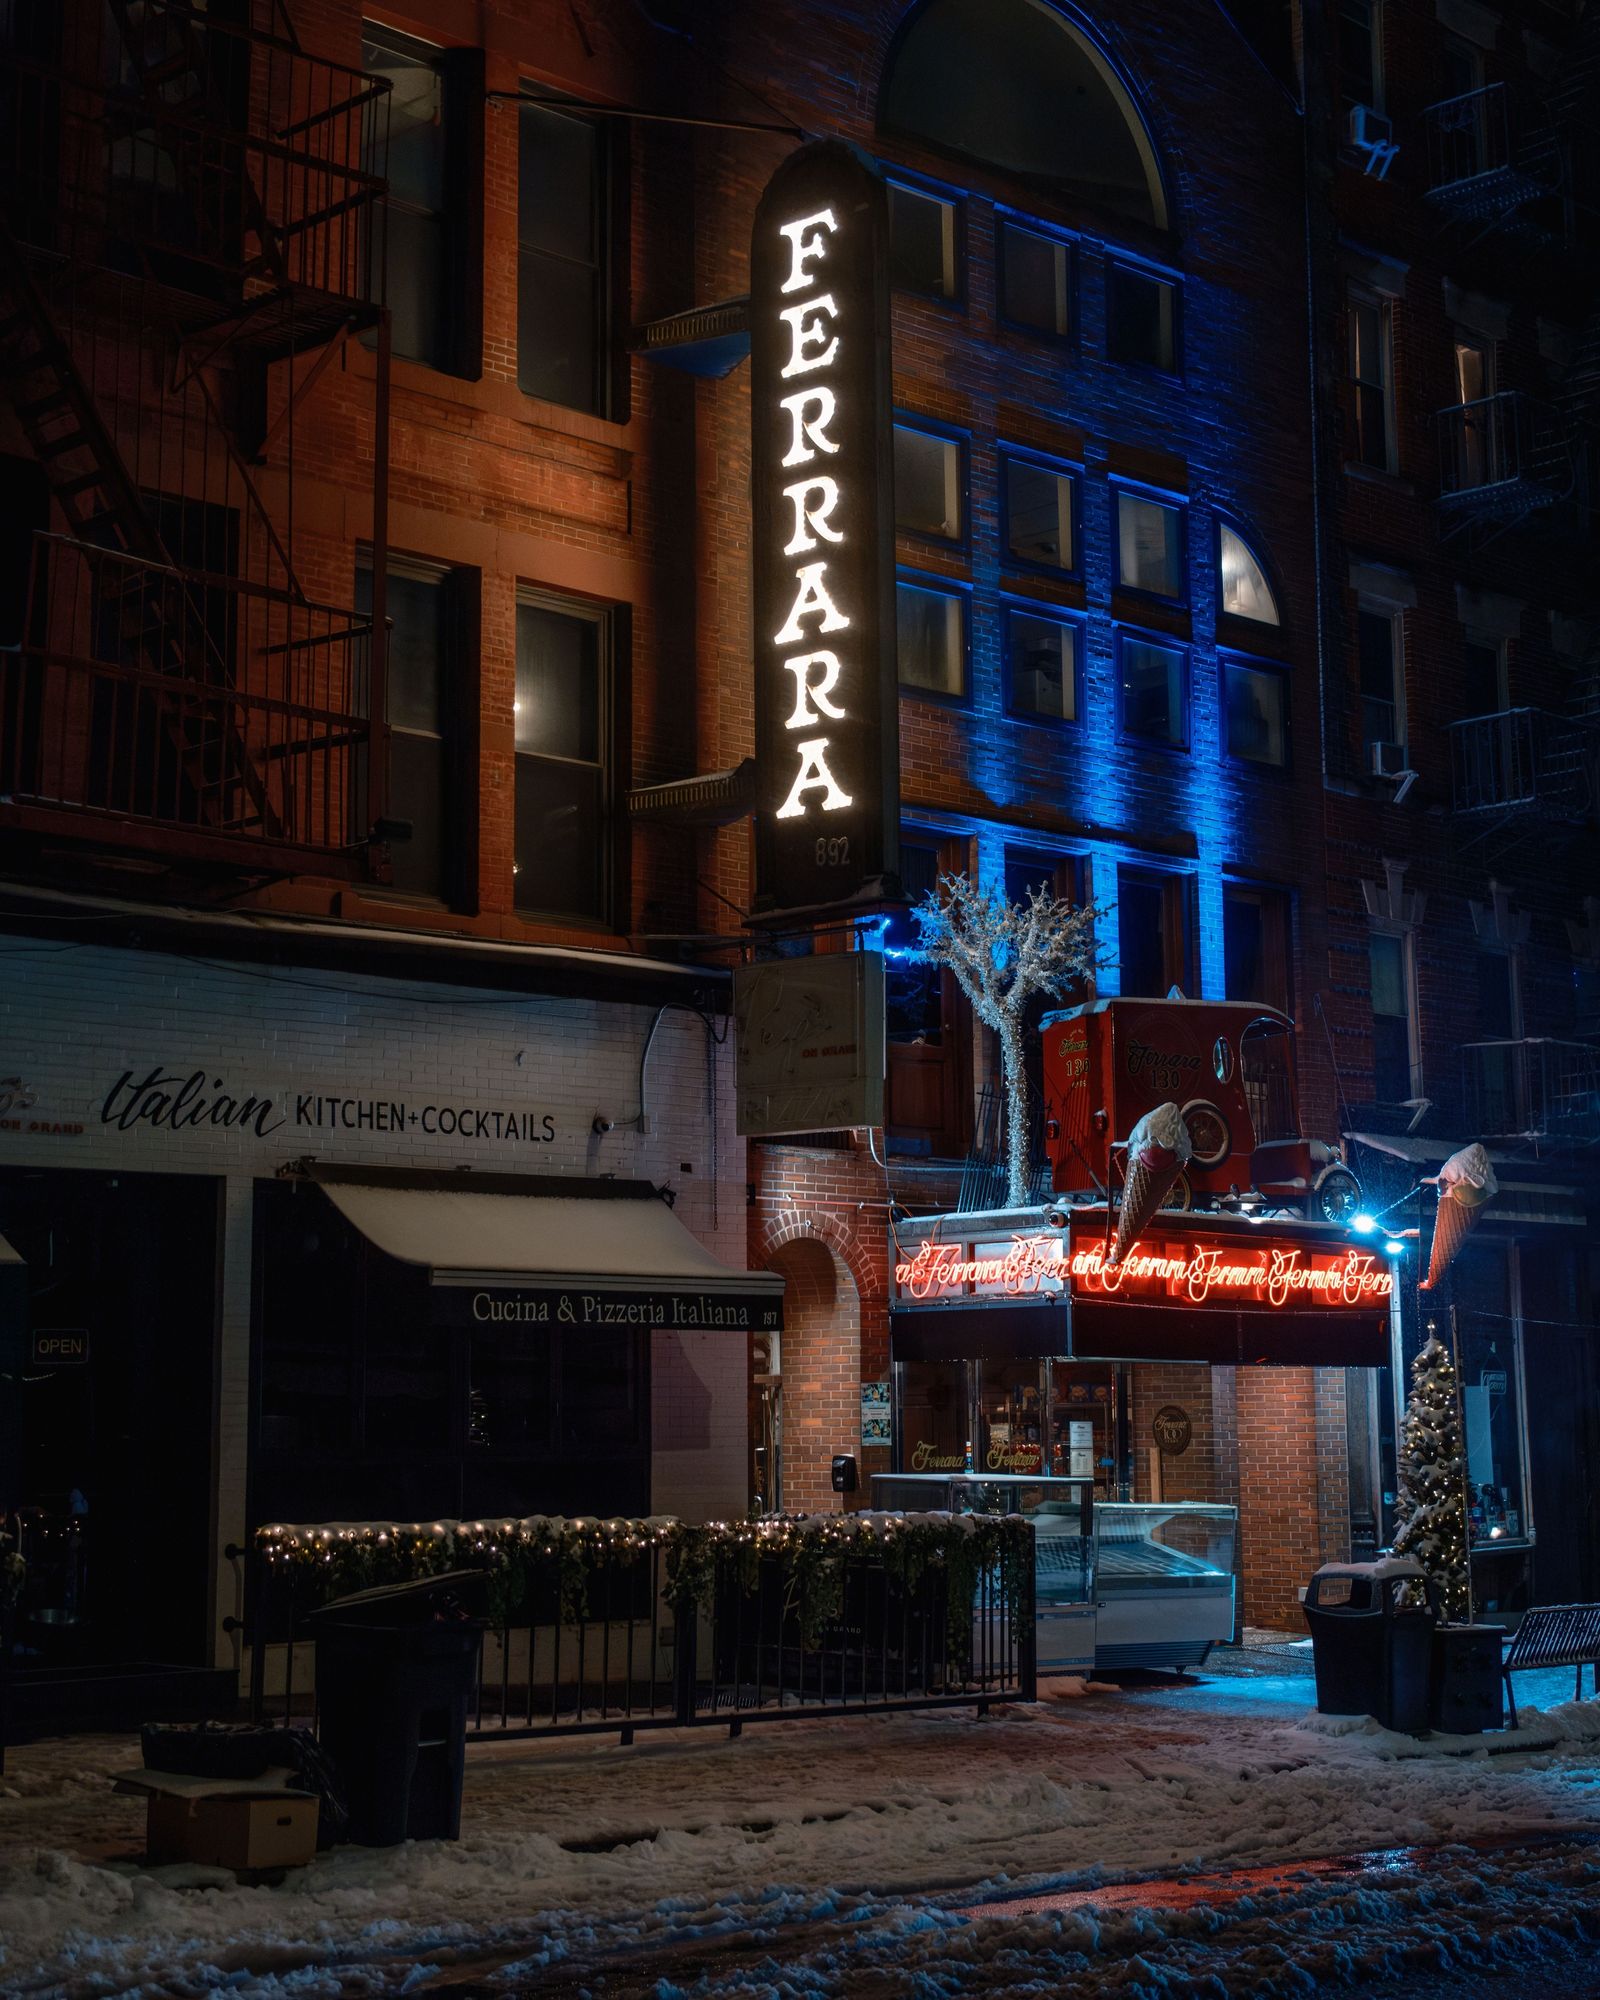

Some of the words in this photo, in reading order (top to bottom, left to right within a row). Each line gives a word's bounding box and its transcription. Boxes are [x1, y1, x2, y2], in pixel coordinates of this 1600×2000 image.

[775, 208, 853, 819] FERRARA
[1127, 1040, 1202, 1074] Ferrara
[1150, 1069, 1181, 1089] 130
[101, 1067, 286, 1137] Italian
[472, 1292, 549, 1323] Cucina
[557, 1295, 578, 1323] &
[582, 1296, 665, 1325] Pizzeria
[671, 1296, 750, 1326] Italiana
[38, 1339, 82, 1354] OPEN
[911, 1440, 966, 1471] Ferrara
